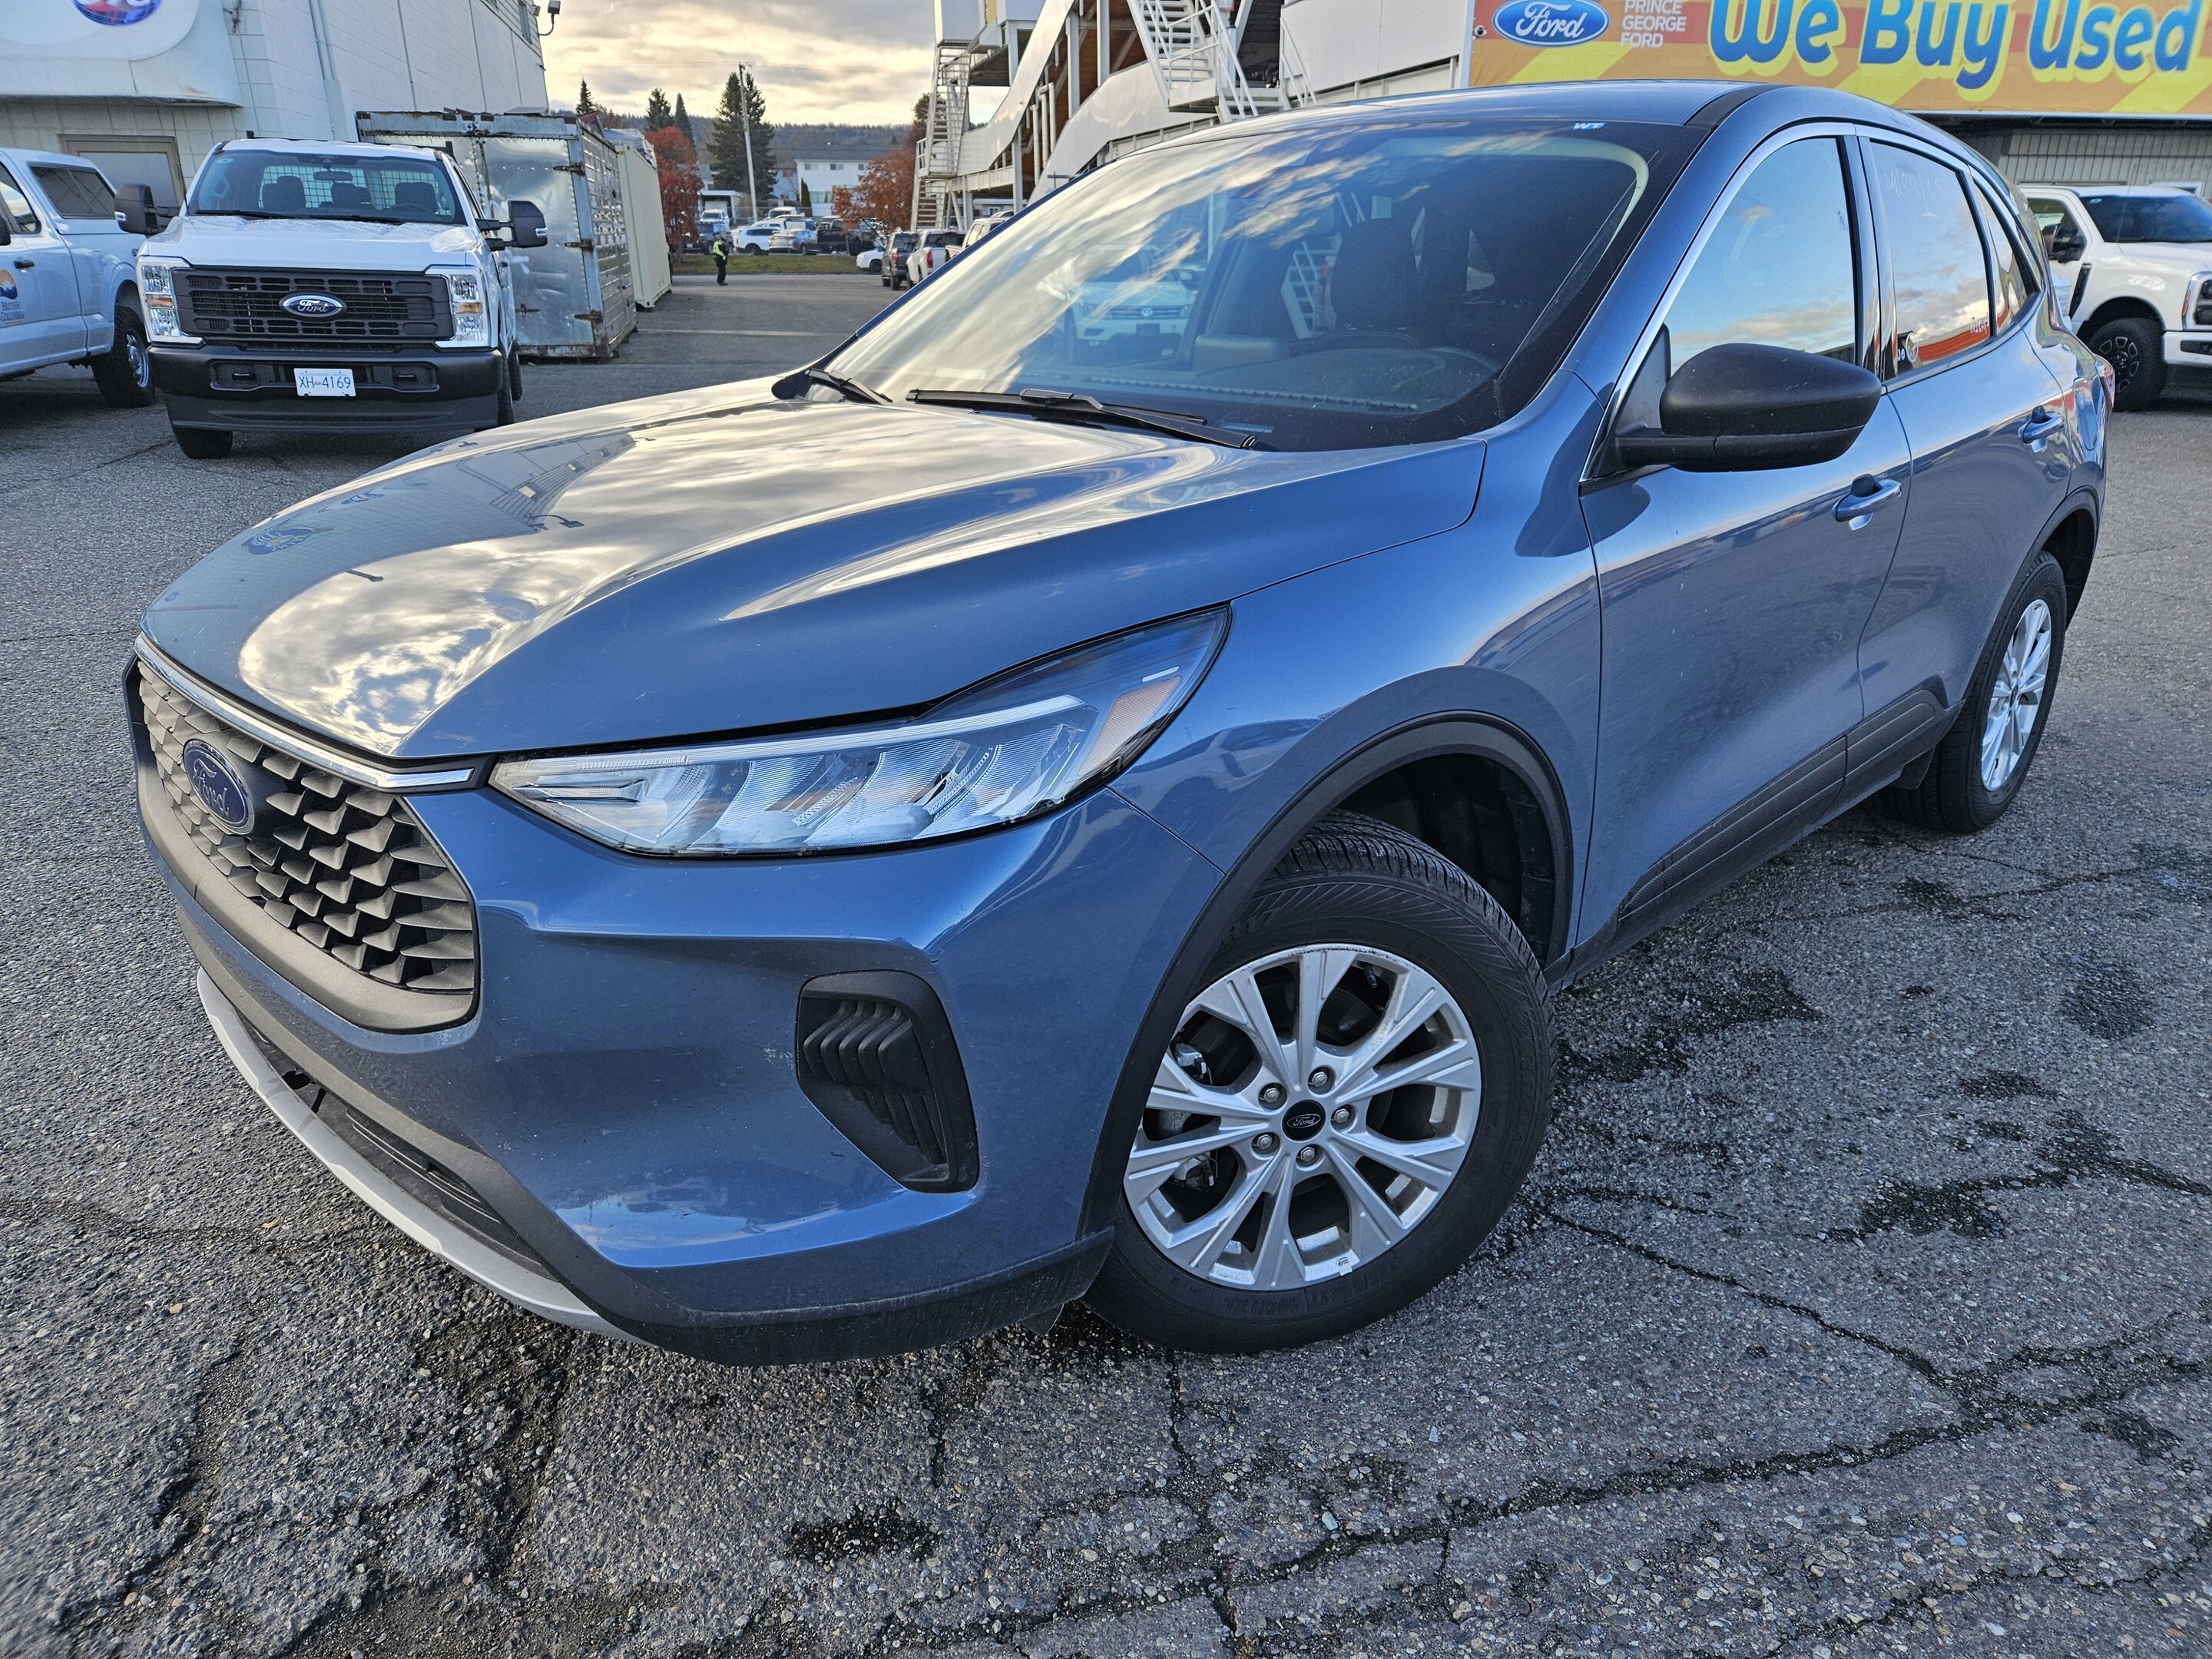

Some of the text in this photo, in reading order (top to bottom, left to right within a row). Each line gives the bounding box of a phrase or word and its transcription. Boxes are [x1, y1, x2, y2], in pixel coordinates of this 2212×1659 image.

[1624, 0, 1684, 15] PRINCE
[1515, 2, 1588, 38] Ford
[1622, 15, 1687, 31] GEORGE
[1620, 32, 1664, 48] FORD
[1709, 0, 2203, 89] We Buy Used
[296, 299, 329, 313] Ford
[192, 757, 230, 817] Ford
[1293, 1116, 1316, 1127] Ford
